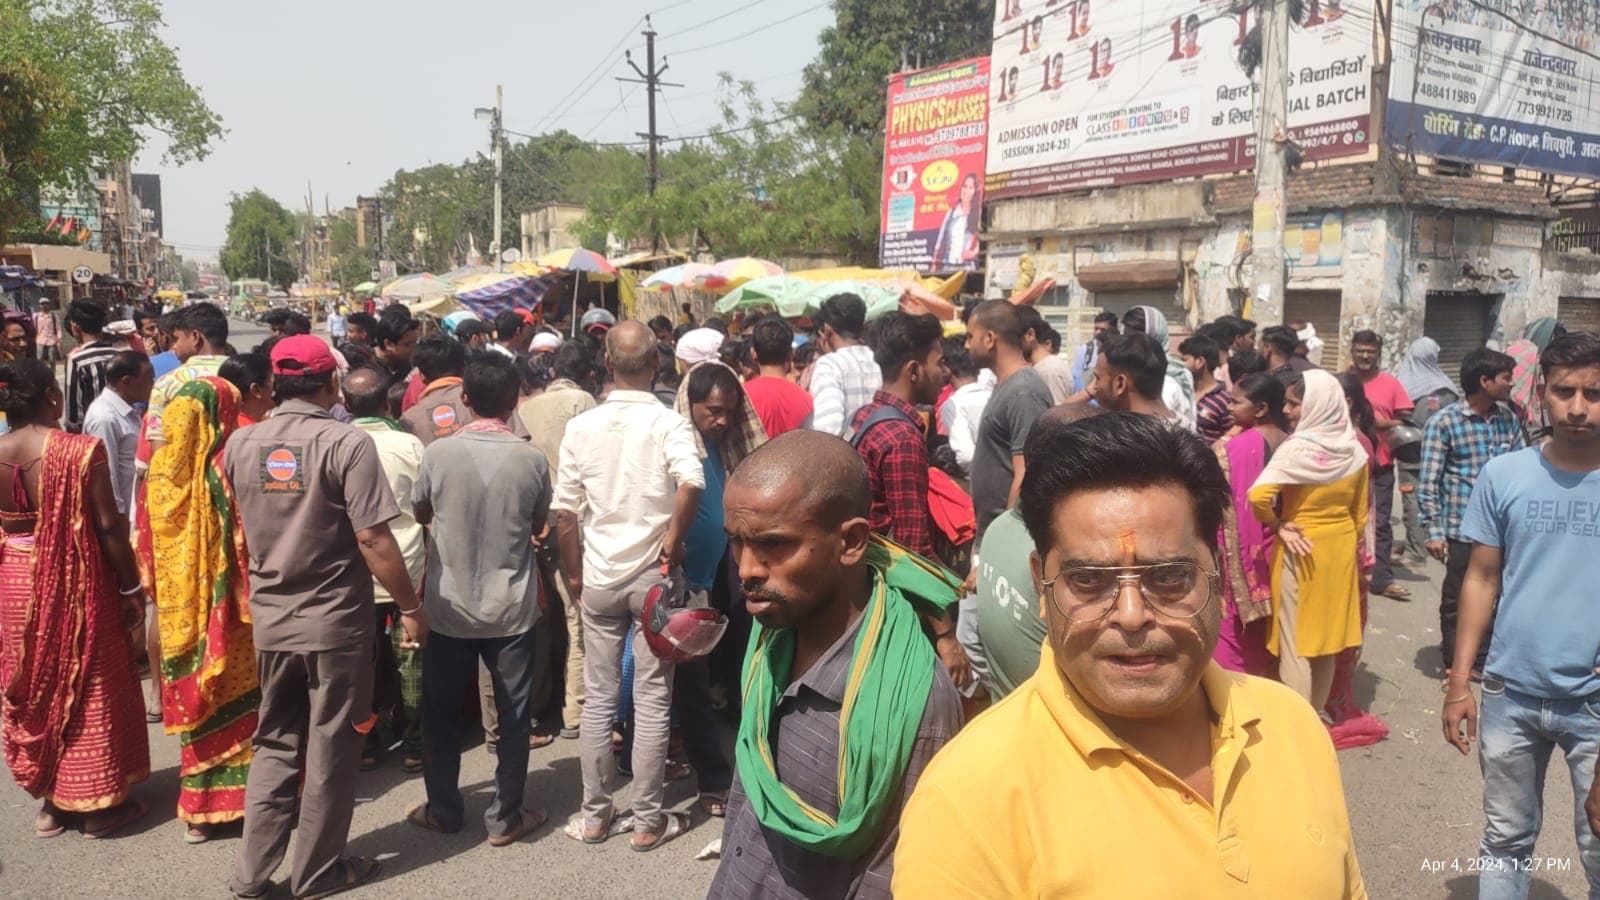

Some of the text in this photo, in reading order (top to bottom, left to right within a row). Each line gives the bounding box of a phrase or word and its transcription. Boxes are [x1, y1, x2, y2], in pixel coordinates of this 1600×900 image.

[1316, 84, 1367, 109] BATCH
[891, 96, 946, 136] PHYSICS
[998, 115, 1079, 145] ADMISSION OPEN
[76, 269, 91, 278] 20
[1525, 519, 1568, 535] YOUR
